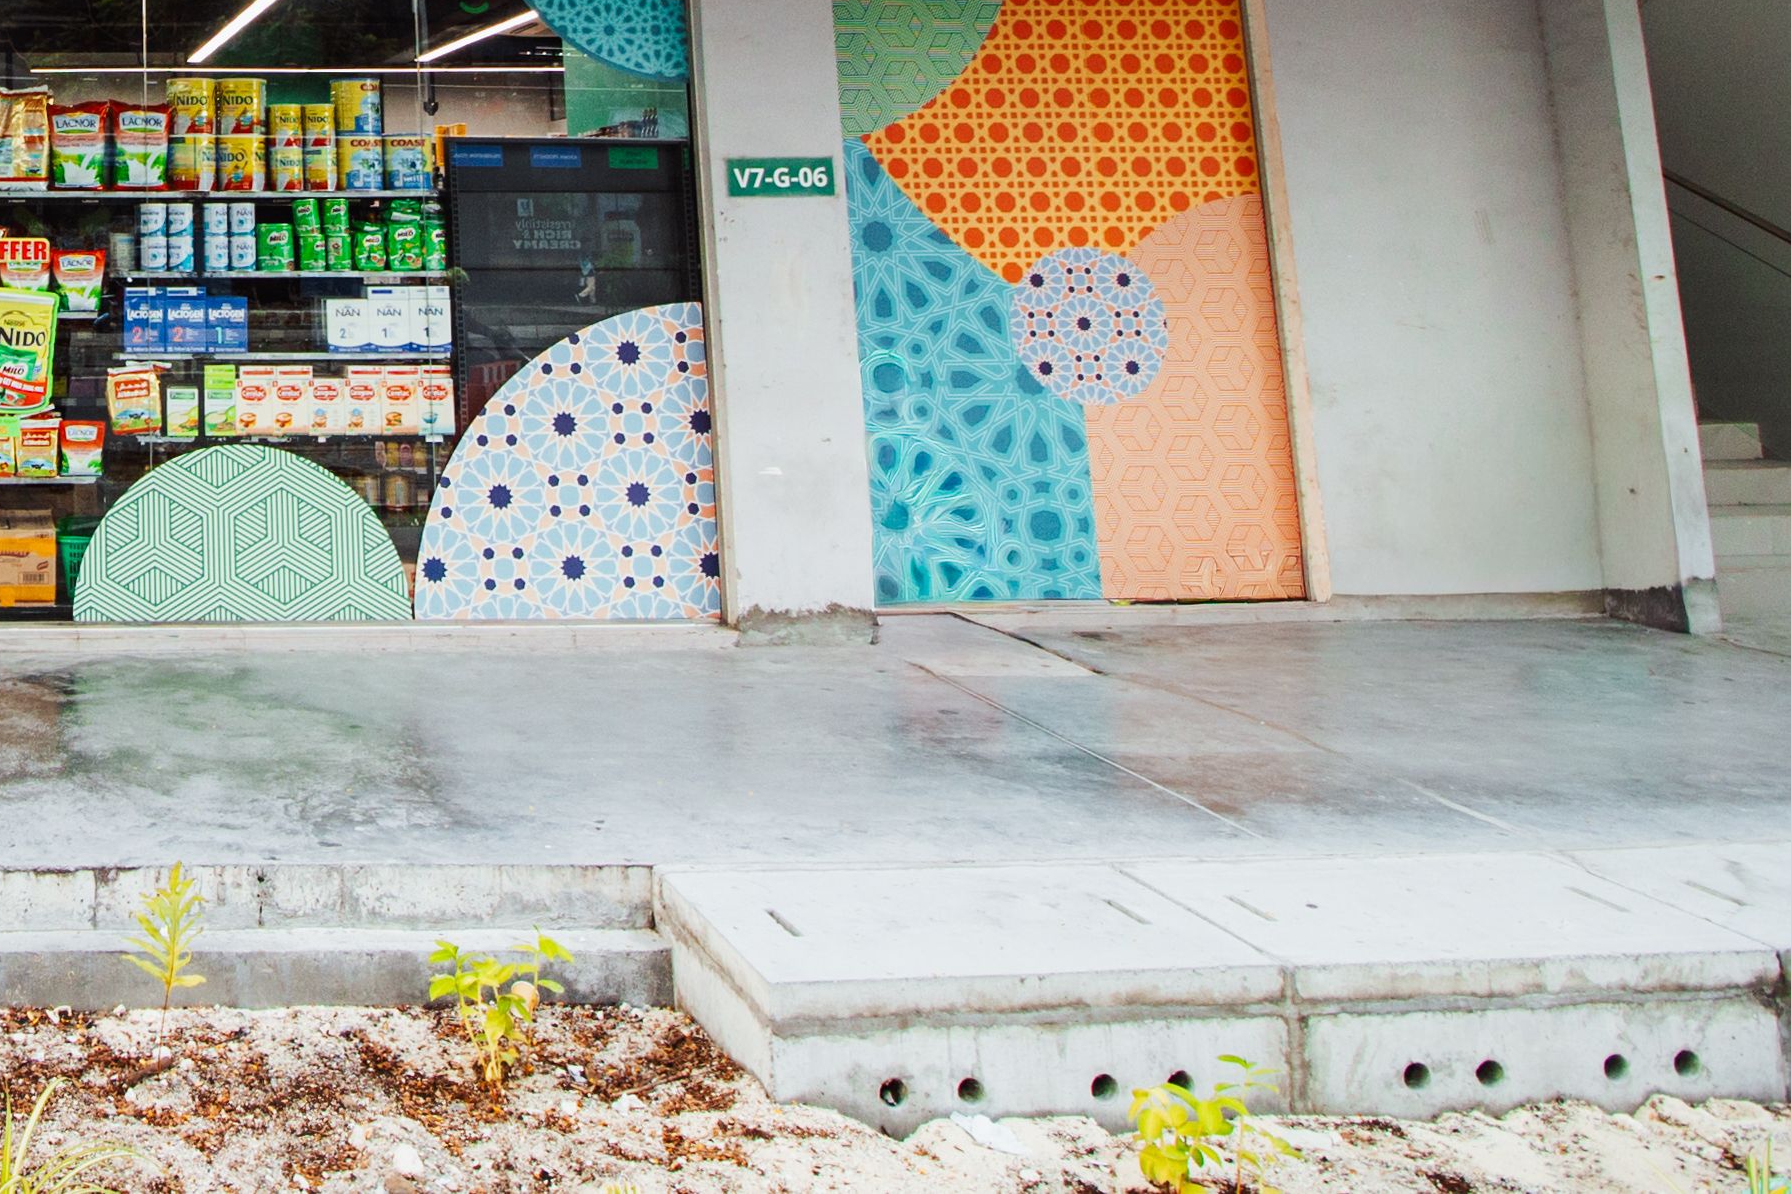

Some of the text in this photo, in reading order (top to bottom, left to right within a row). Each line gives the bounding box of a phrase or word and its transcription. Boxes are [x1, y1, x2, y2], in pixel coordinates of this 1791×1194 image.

[176, 96, 208, 106] NIDO
[222, 95, 253, 106] NIDO
[55, 116, 97, 129] LACNOR
[122, 115, 163, 129] LACNOR
[733, 166, 828, 188] V7-G-06
[127, 308, 163, 321] LACTOGEN
[167, 308, 204, 321] LACTOGEN
[209, 308, 245, 321] LACTOGEN
[335, 308, 360, 317] NAN
[377, 308, 402, 317] NAN
[418, 307, 443, 316] NAN
[132, 326, 143, 343] 2
[172, 326, 184, 342] 2
[215, 326, 223, 344] 1
[340, 328, 346, 339] 2
[382, 328, 388, 339] 1
[424, 327, 430, 338] 1
[1, 365, 25, 376] MILO
